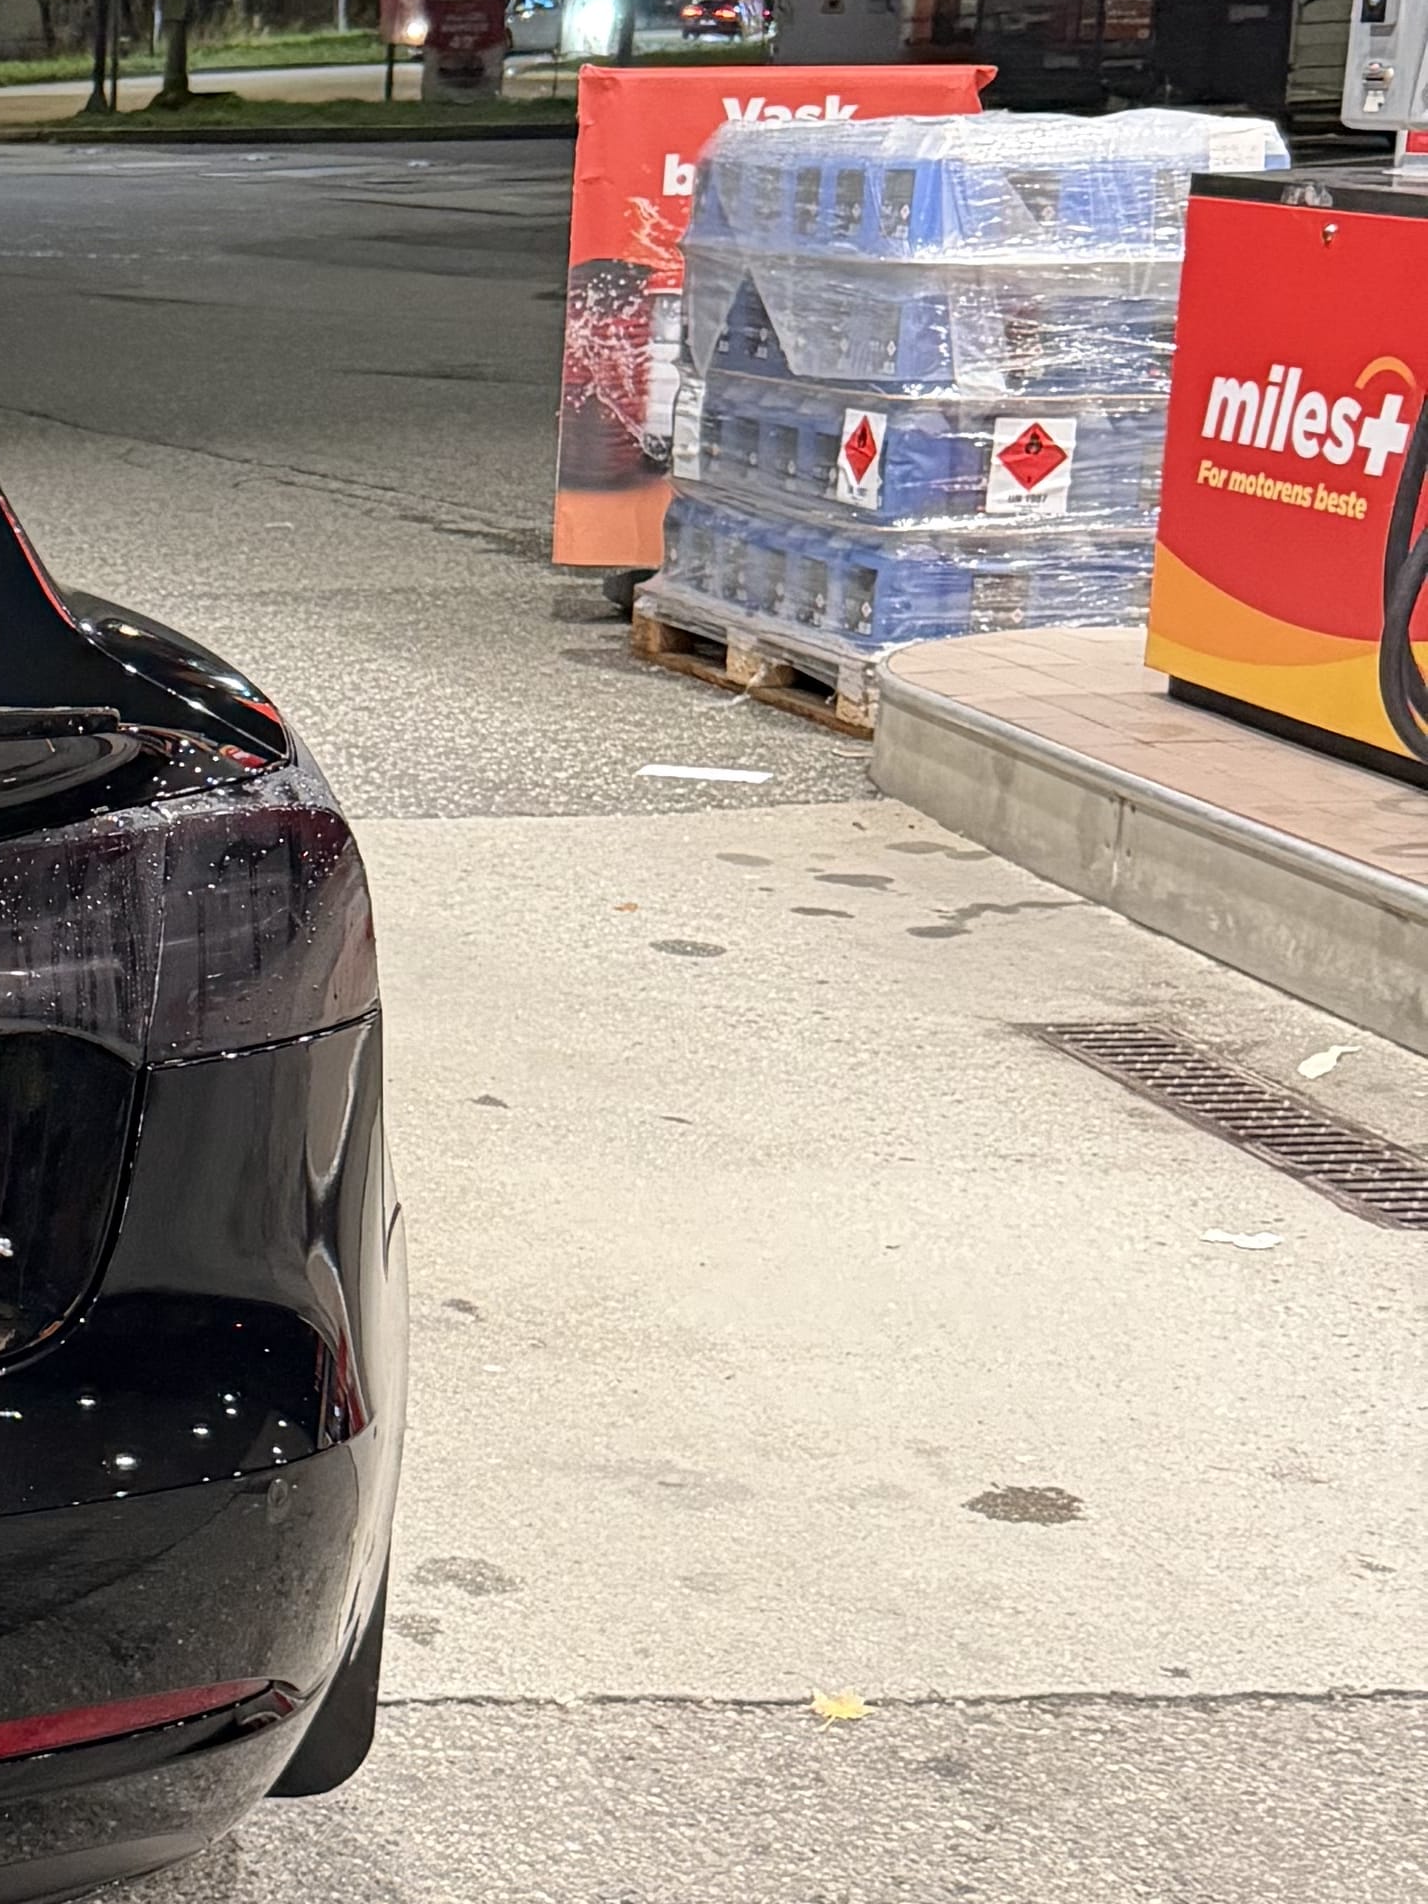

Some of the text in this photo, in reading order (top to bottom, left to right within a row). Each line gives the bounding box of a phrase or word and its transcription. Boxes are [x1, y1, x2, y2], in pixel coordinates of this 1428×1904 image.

[1197, 459, 1368, 521] For motorens beste
